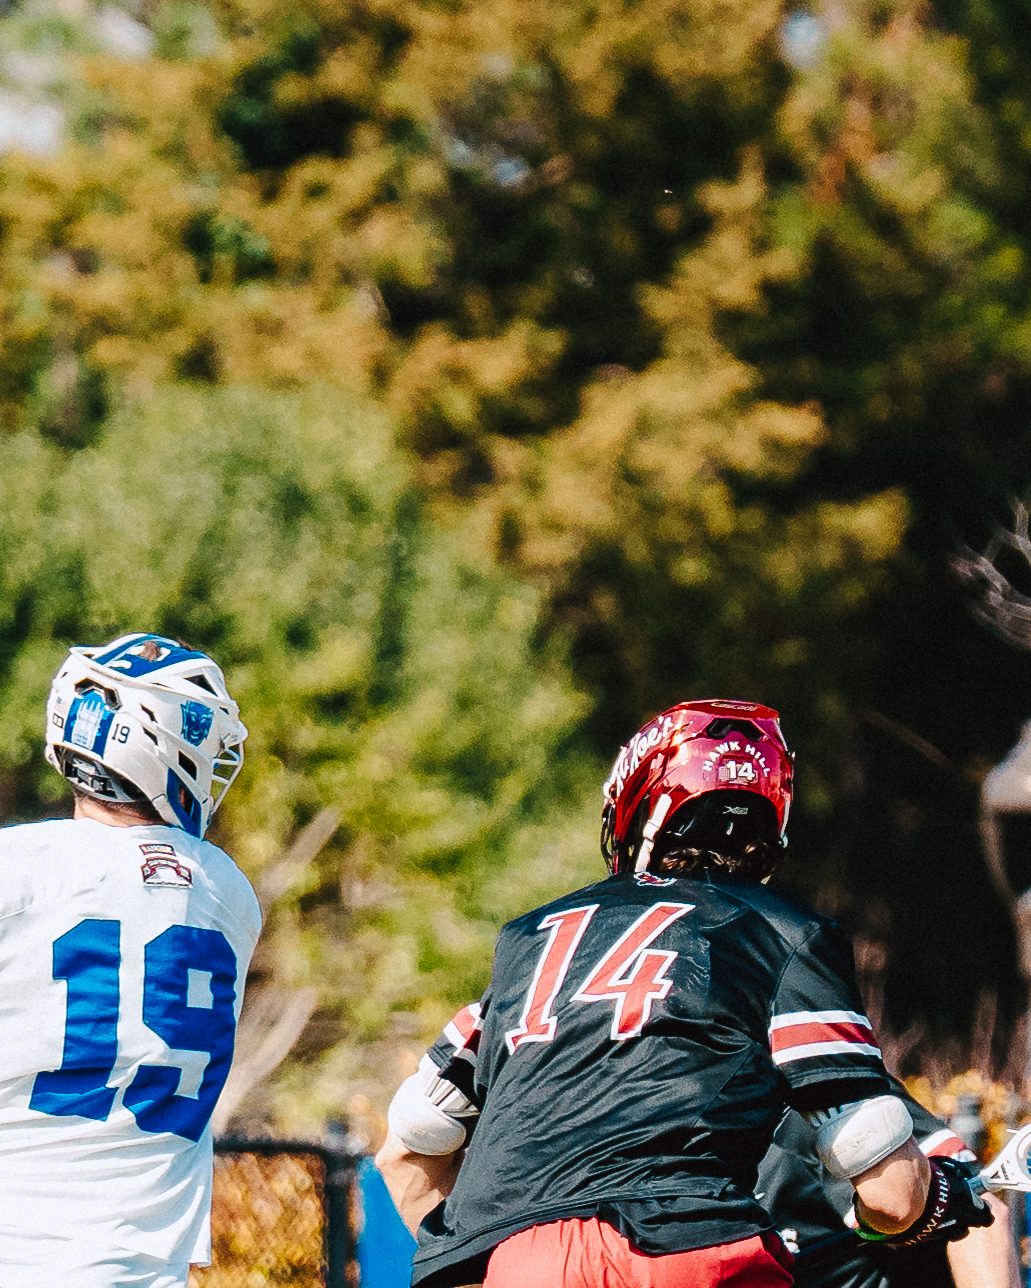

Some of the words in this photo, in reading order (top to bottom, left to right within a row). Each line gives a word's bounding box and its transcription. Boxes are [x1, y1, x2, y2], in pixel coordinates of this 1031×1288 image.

[111, 723, 131, 744] 19
[702, 741, 741, 771] HAWK
[745, 744, 771, 778] HILL
[726, 760, 755, 780] 14
[505, 902, 697, 1056] 14
[28, 918, 238, 1143] 19
[904, 1205, 945, 1246] HAWK
[935, 1169, 949, 1204] HILL
